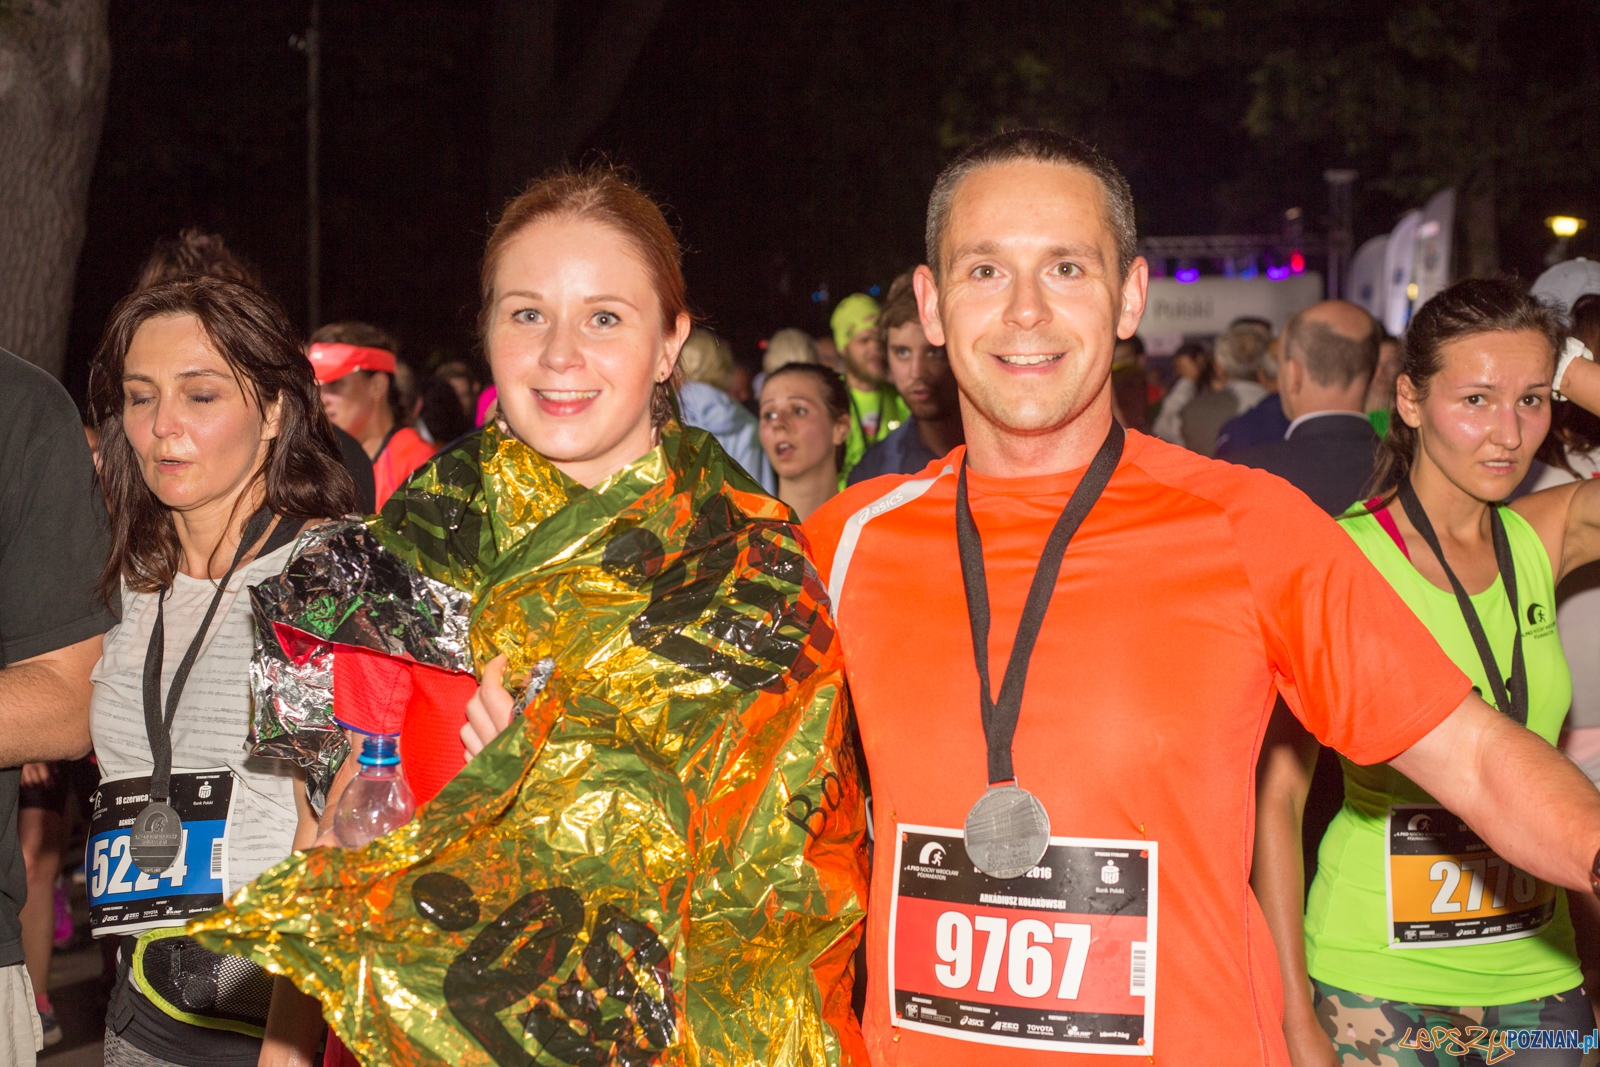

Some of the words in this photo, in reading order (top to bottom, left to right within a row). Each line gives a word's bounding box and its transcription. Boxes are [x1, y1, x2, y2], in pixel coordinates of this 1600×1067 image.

[871, 492, 904, 515] asics
[122, 793, 149, 804] czerwca
[1429, 857, 1537, 914] 2778
[979, 893, 1018, 906] ARKADIUSZ
[1017, 896, 1067, 910] KOŁAKOWSKI
[934, 910, 1092, 1001] 9767
[1026, 1023, 1055, 1033] TOYOTA
